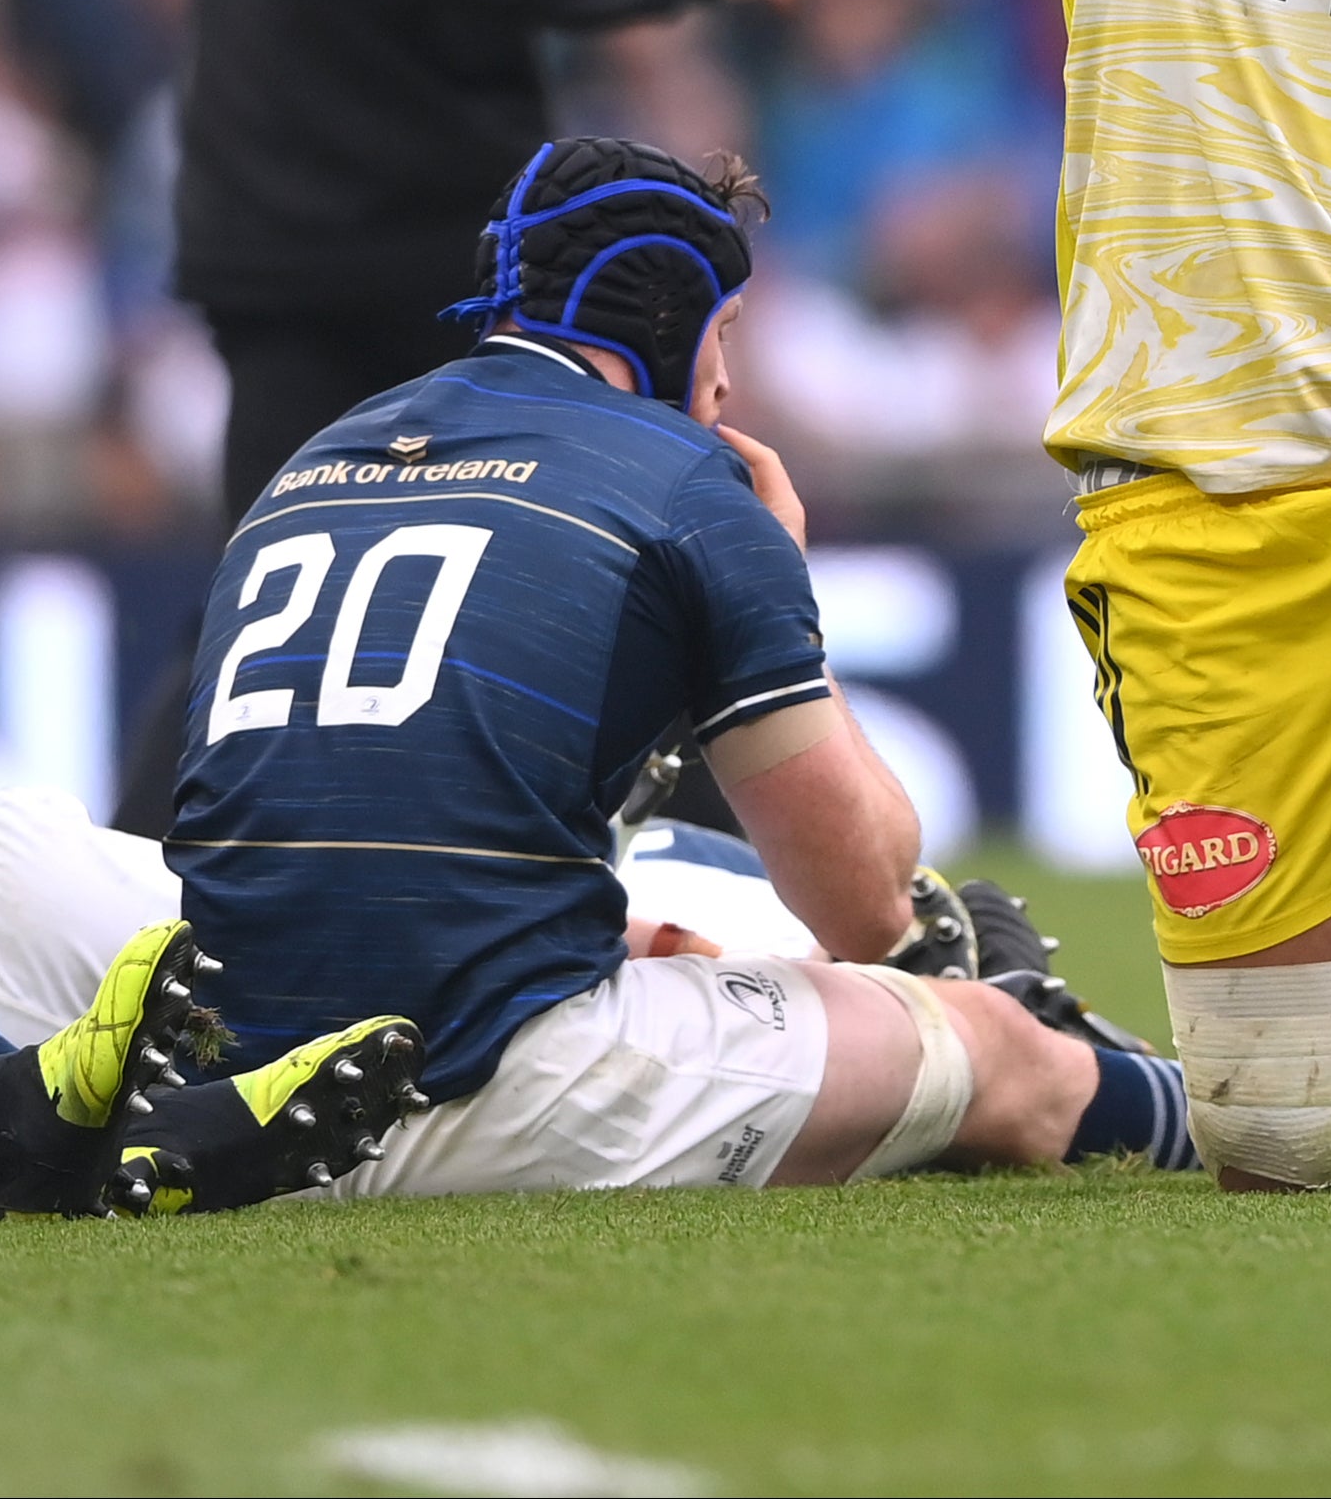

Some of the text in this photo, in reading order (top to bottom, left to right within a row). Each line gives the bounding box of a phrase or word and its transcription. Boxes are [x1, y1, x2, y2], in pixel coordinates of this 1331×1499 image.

[271, 460, 354, 499] Bank
[396, 458, 539, 484] Ireland
[206, 523, 495, 748] 20
[741, 1123, 755, 1142] of
